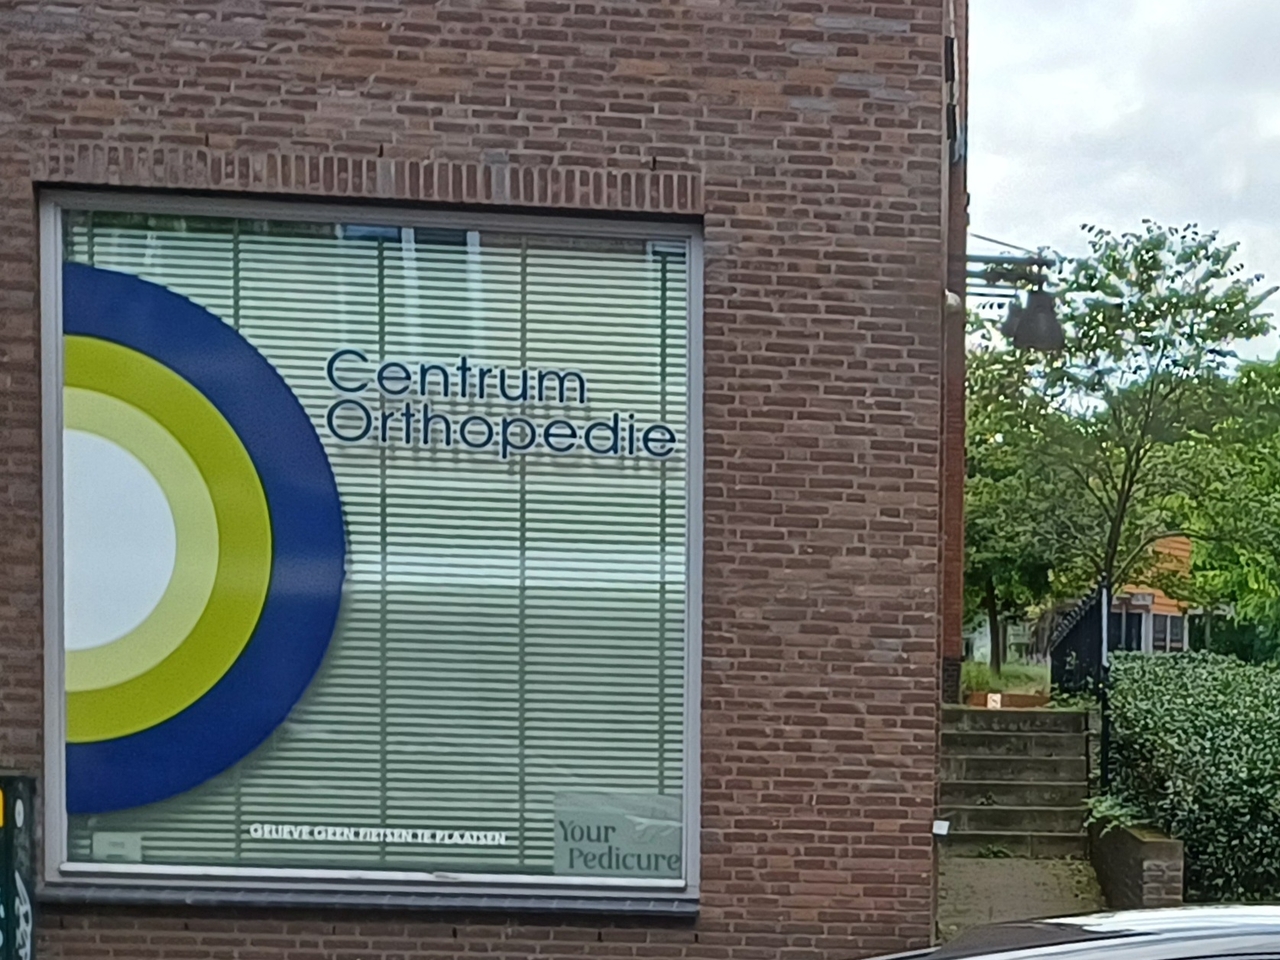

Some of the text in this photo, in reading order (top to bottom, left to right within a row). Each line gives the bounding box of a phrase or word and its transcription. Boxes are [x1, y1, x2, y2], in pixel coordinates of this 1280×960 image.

[327, 349, 586, 404] Centrum
[326, 399, 677, 459] Orthopedie
[436, 830, 506, 846] PLAATSEN
[558, 820, 617, 843] Your
[568, 845, 681, 872] Pedicure
